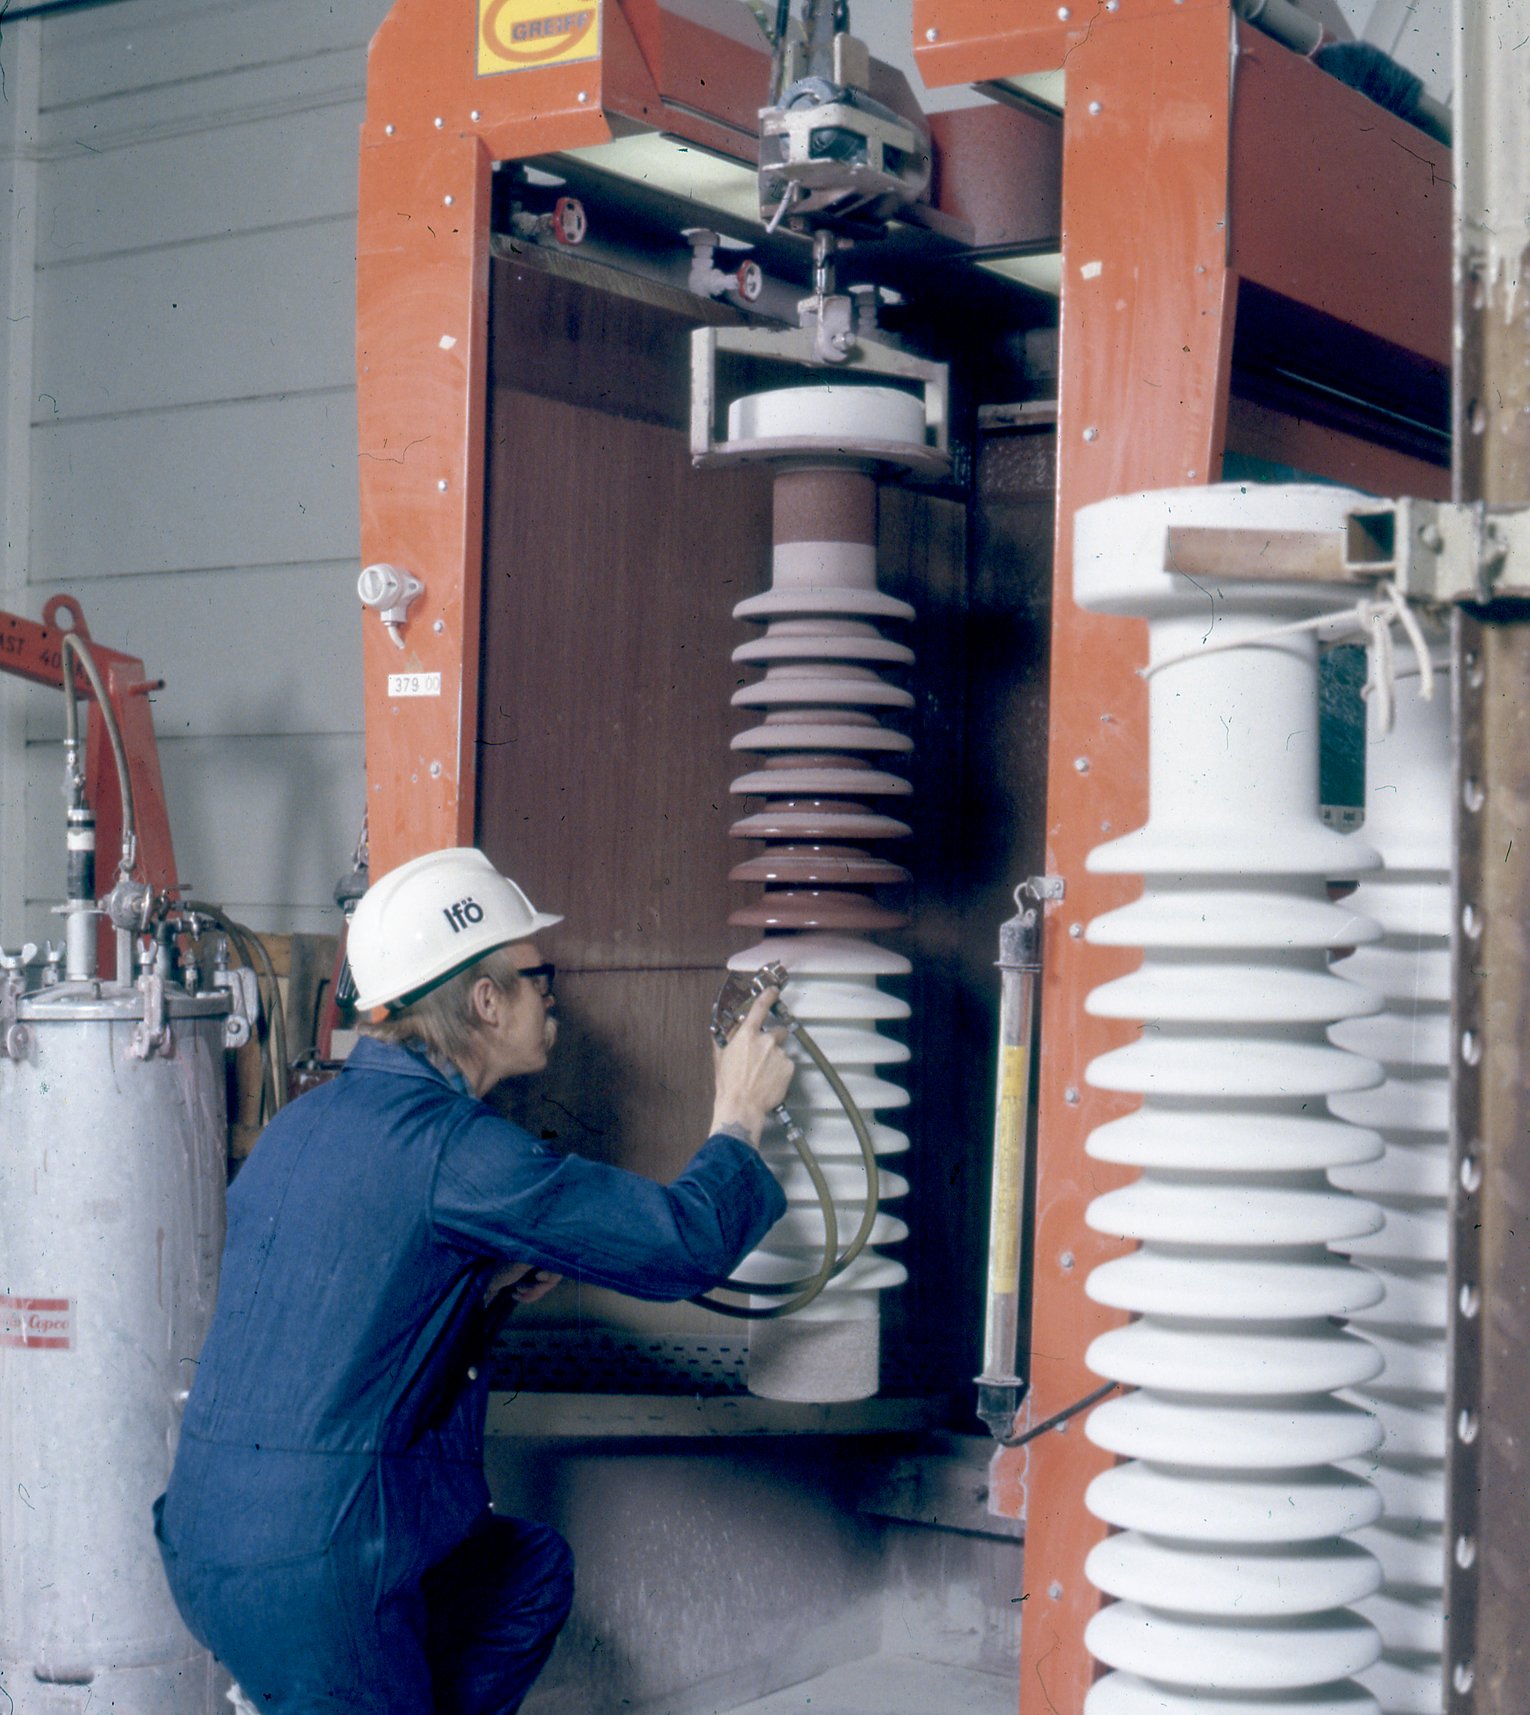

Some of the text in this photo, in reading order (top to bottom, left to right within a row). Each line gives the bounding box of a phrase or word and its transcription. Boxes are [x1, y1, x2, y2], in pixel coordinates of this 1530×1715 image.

[511, 11, 589, 41] GREIFF
[443, 897, 484, 933] Ifö
[29, 1314, 69, 1333] Copco
